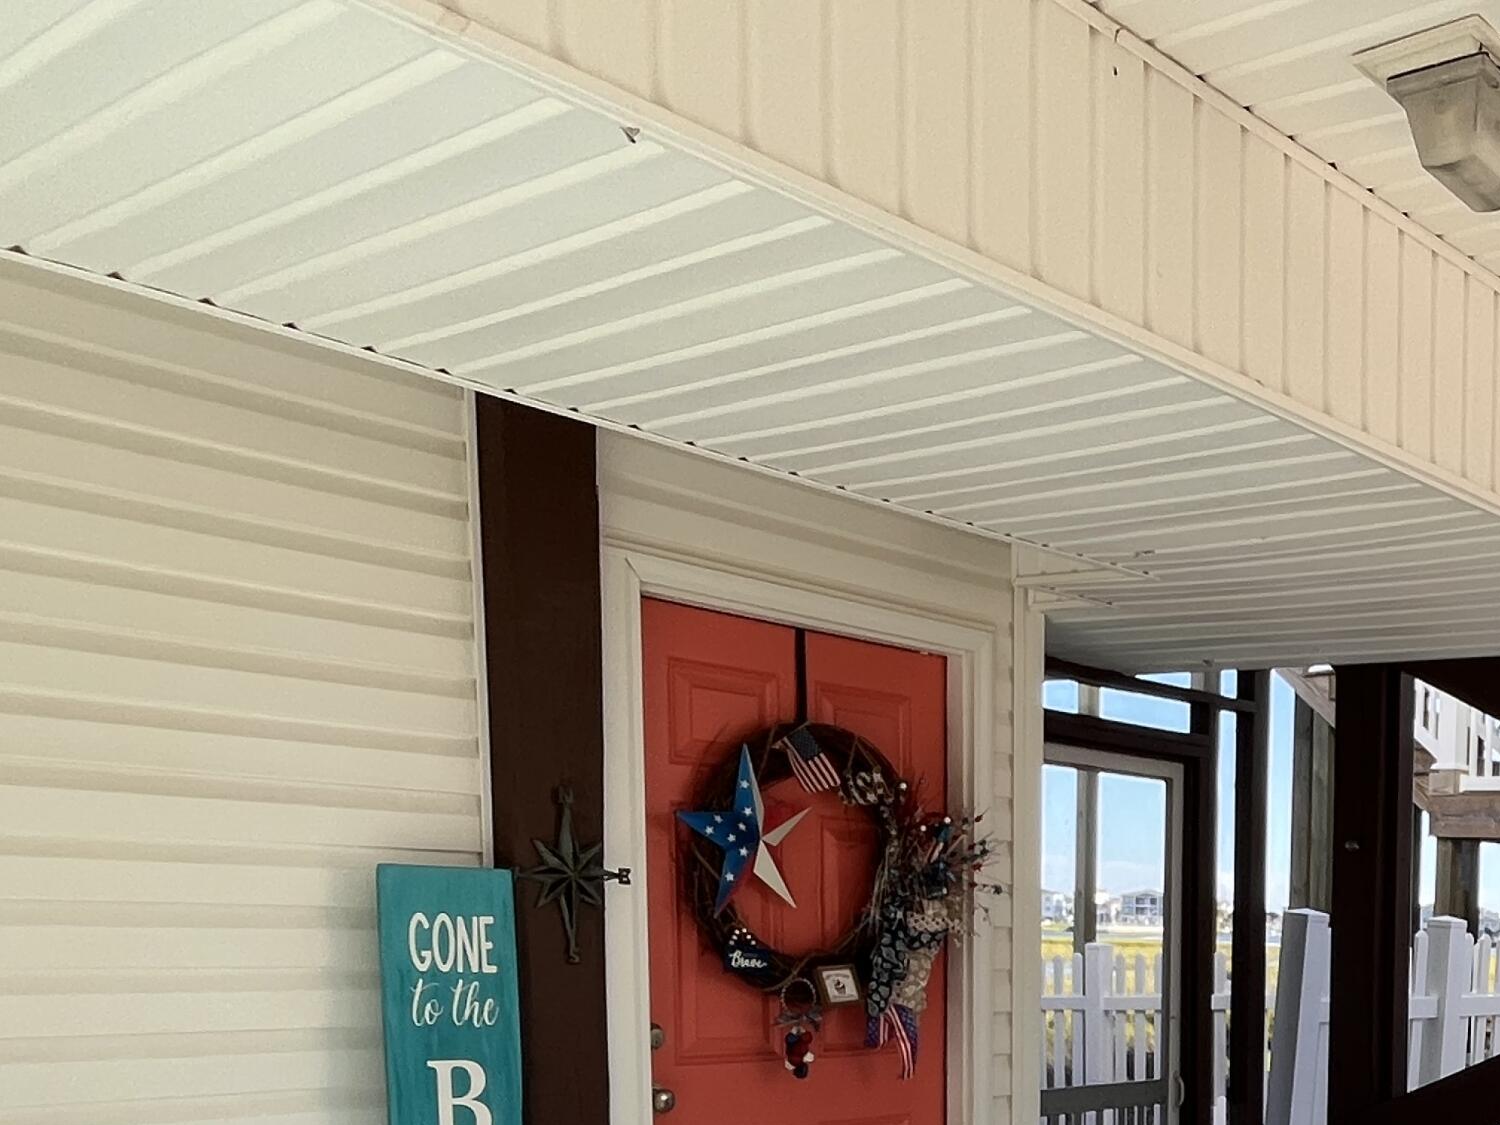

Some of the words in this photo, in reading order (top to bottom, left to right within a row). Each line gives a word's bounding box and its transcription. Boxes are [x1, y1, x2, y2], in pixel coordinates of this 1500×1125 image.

[408, 912, 498, 974] GONE
[410, 978, 443, 1028] to
[450, 978, 500, 1028] the
